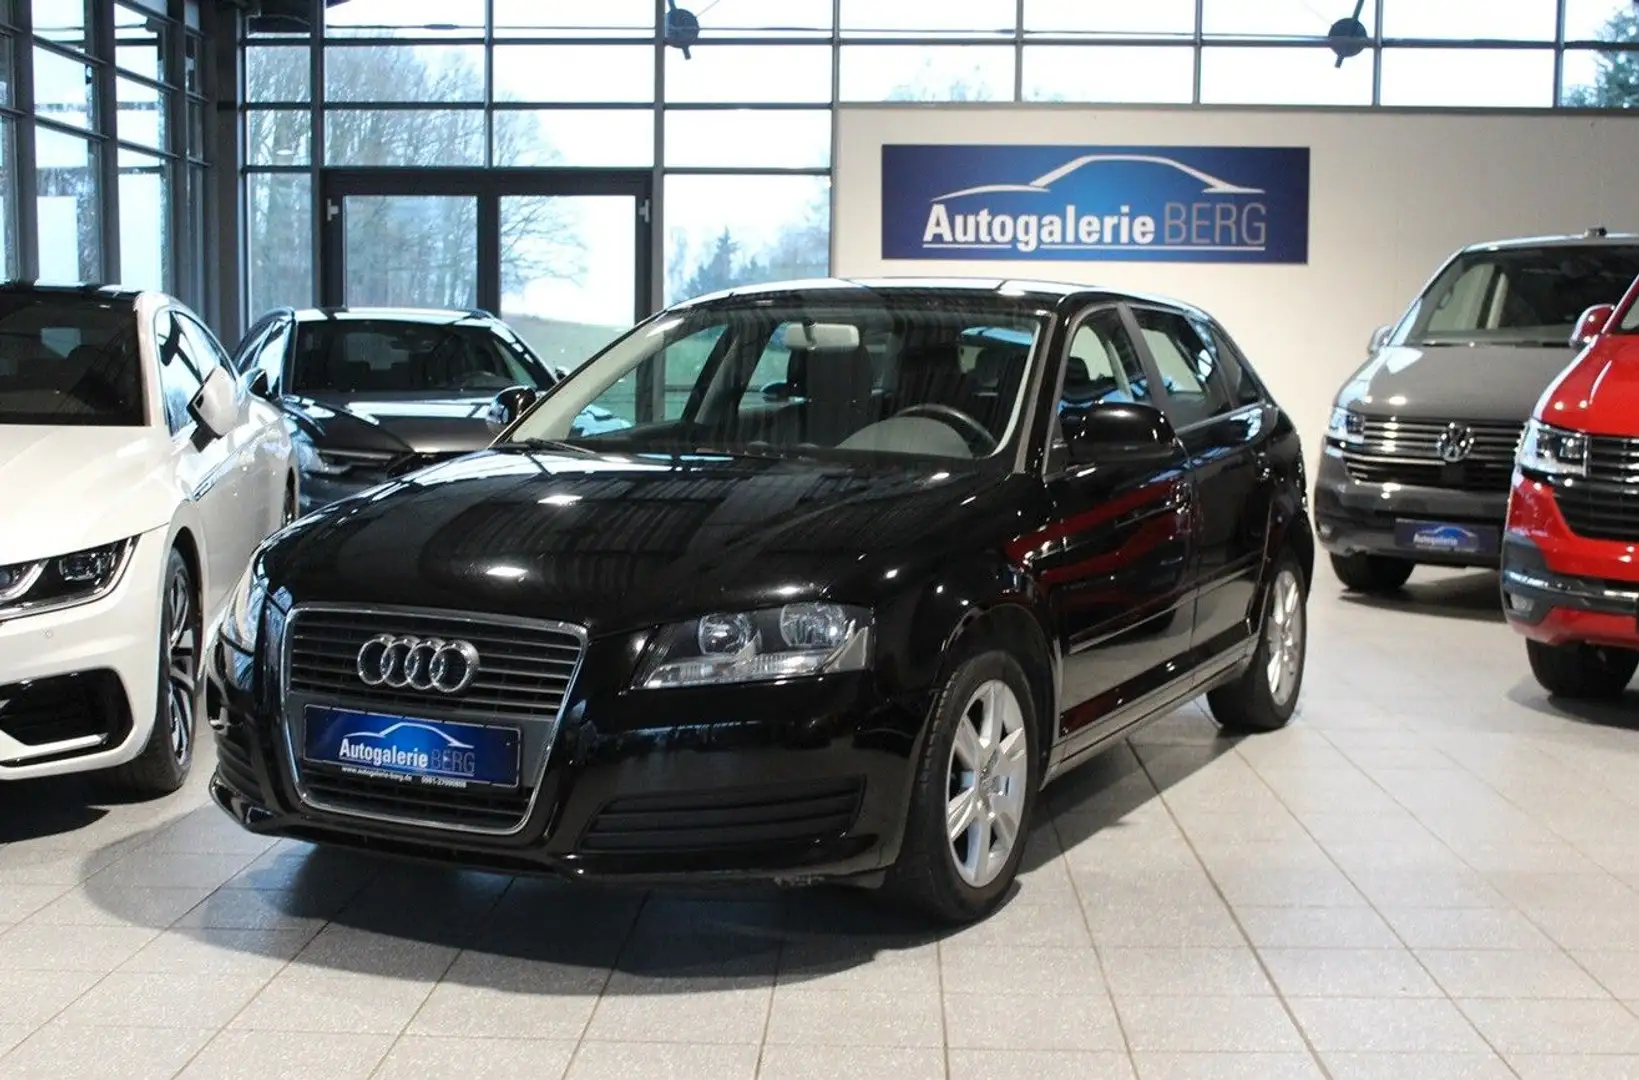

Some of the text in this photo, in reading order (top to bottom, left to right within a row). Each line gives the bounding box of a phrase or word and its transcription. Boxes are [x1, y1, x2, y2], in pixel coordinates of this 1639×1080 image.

[922, 203, 1267, 252] Autogalerie BERG
[339, 738, 475, 774] Autogalerie BERG
